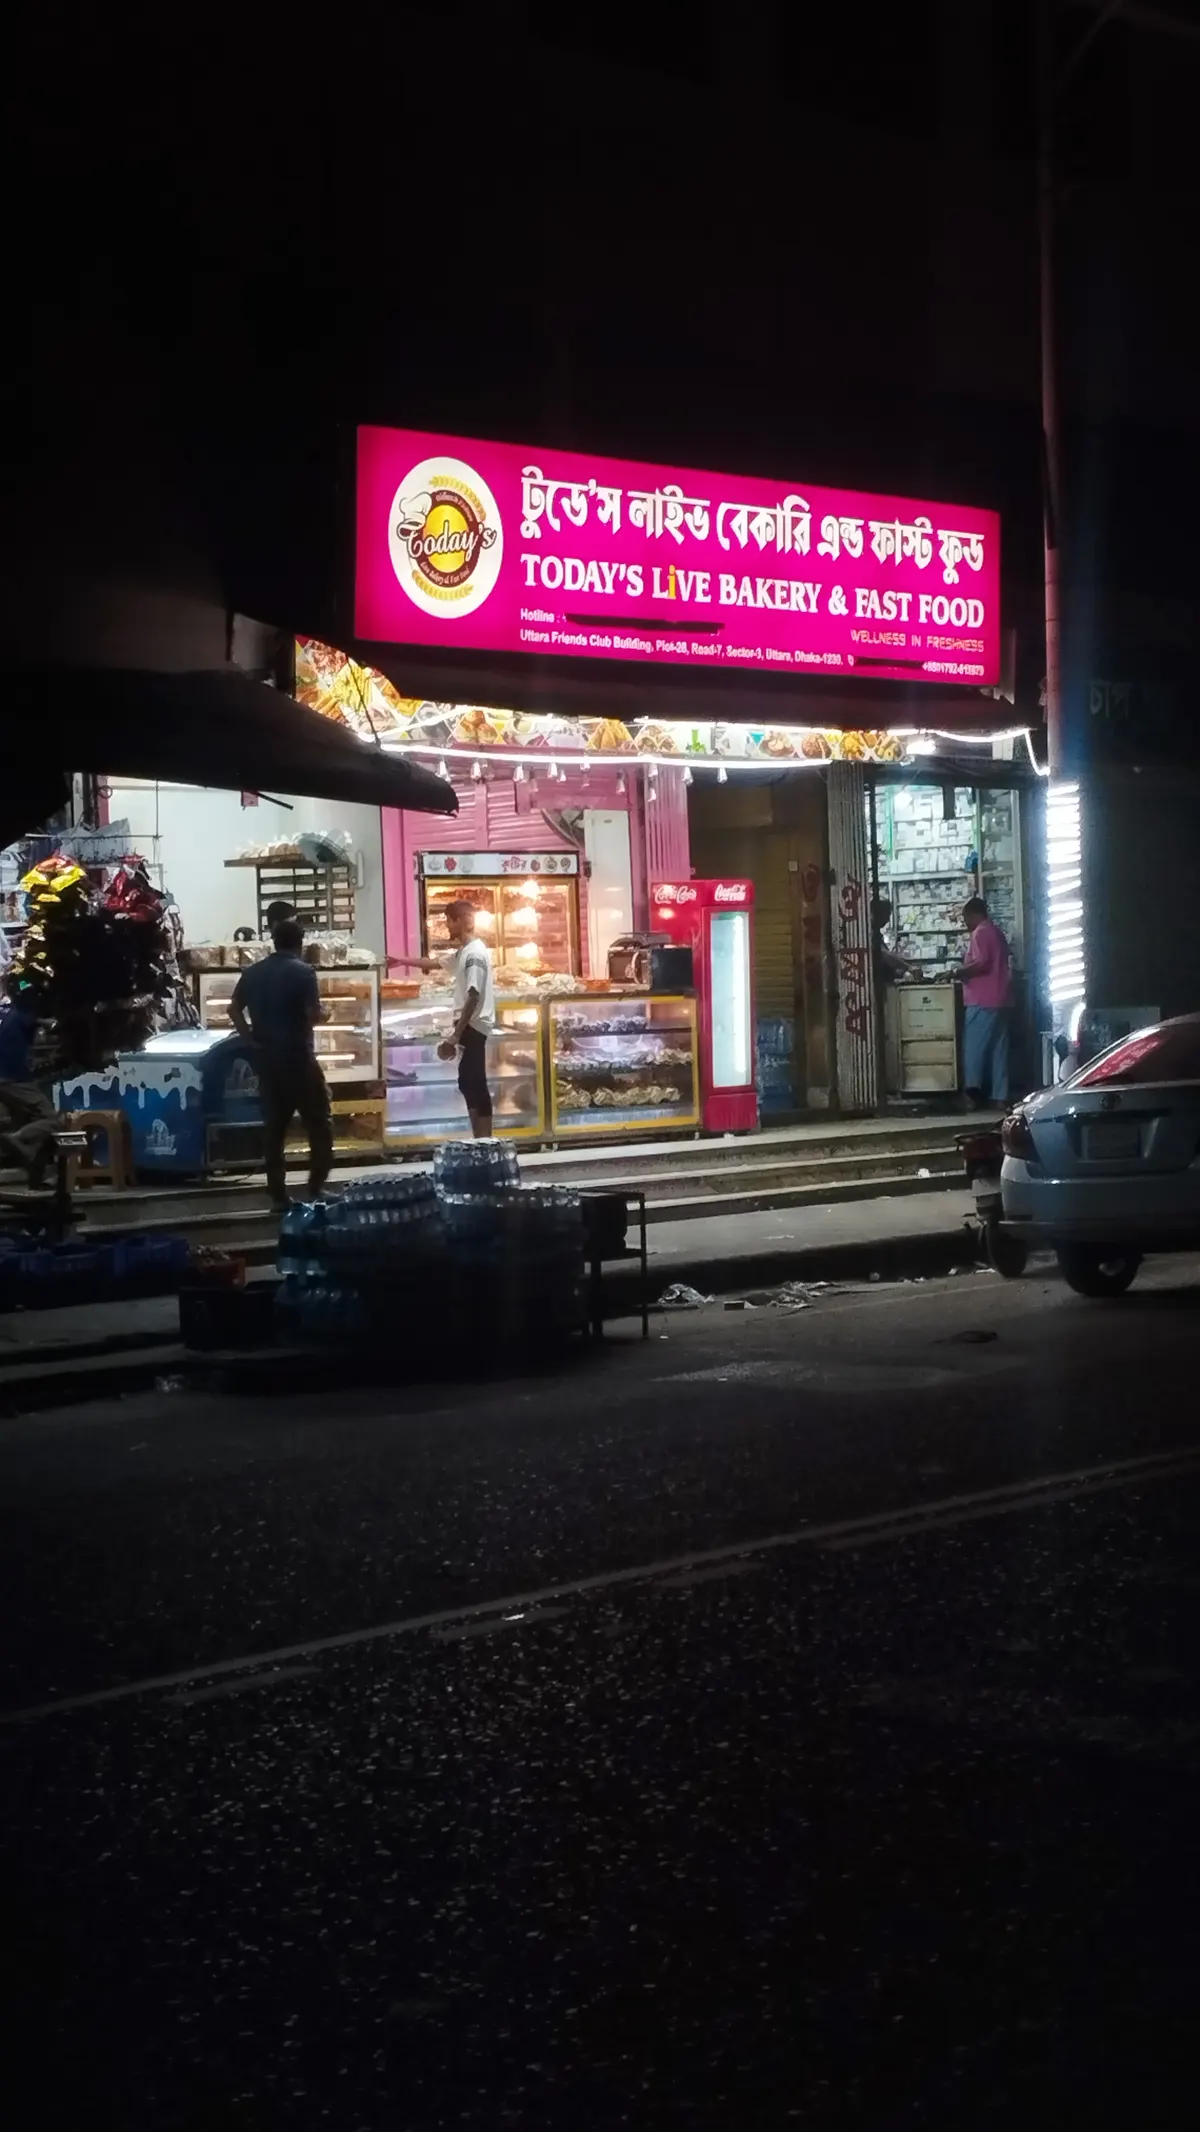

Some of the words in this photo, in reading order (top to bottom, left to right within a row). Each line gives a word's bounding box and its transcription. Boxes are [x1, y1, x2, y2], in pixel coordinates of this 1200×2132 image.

[397, 519, 498, 562] Today's
[627, 485, 710, 544] লাইভ
[716, 495, 812, 555] বেকারি
[817, 516, 864, 561] এন্ড
[868, 517, 933, 569] ফাস্ট
[937, 530, 984, 584] ফুড
[520, 554, 643, 596] TODAY'S
[719, 574, 822, 613] BAKERY
[828, 585, 848, 615] &
[855, 588, 912, 621] FAST
[919, 595, 984, 627] FOOD
[520, 608, 555, 623] Hotline
[520, 628, 550, 643] Uttara
[551, 631, 588, 646] Friends
[588, 634, 613, 648] Club
[850, 629, 906, 647] WELLNESS
[911, 634, 922, 648] IN
[926, 635, 984, 653] FRESHNESS
